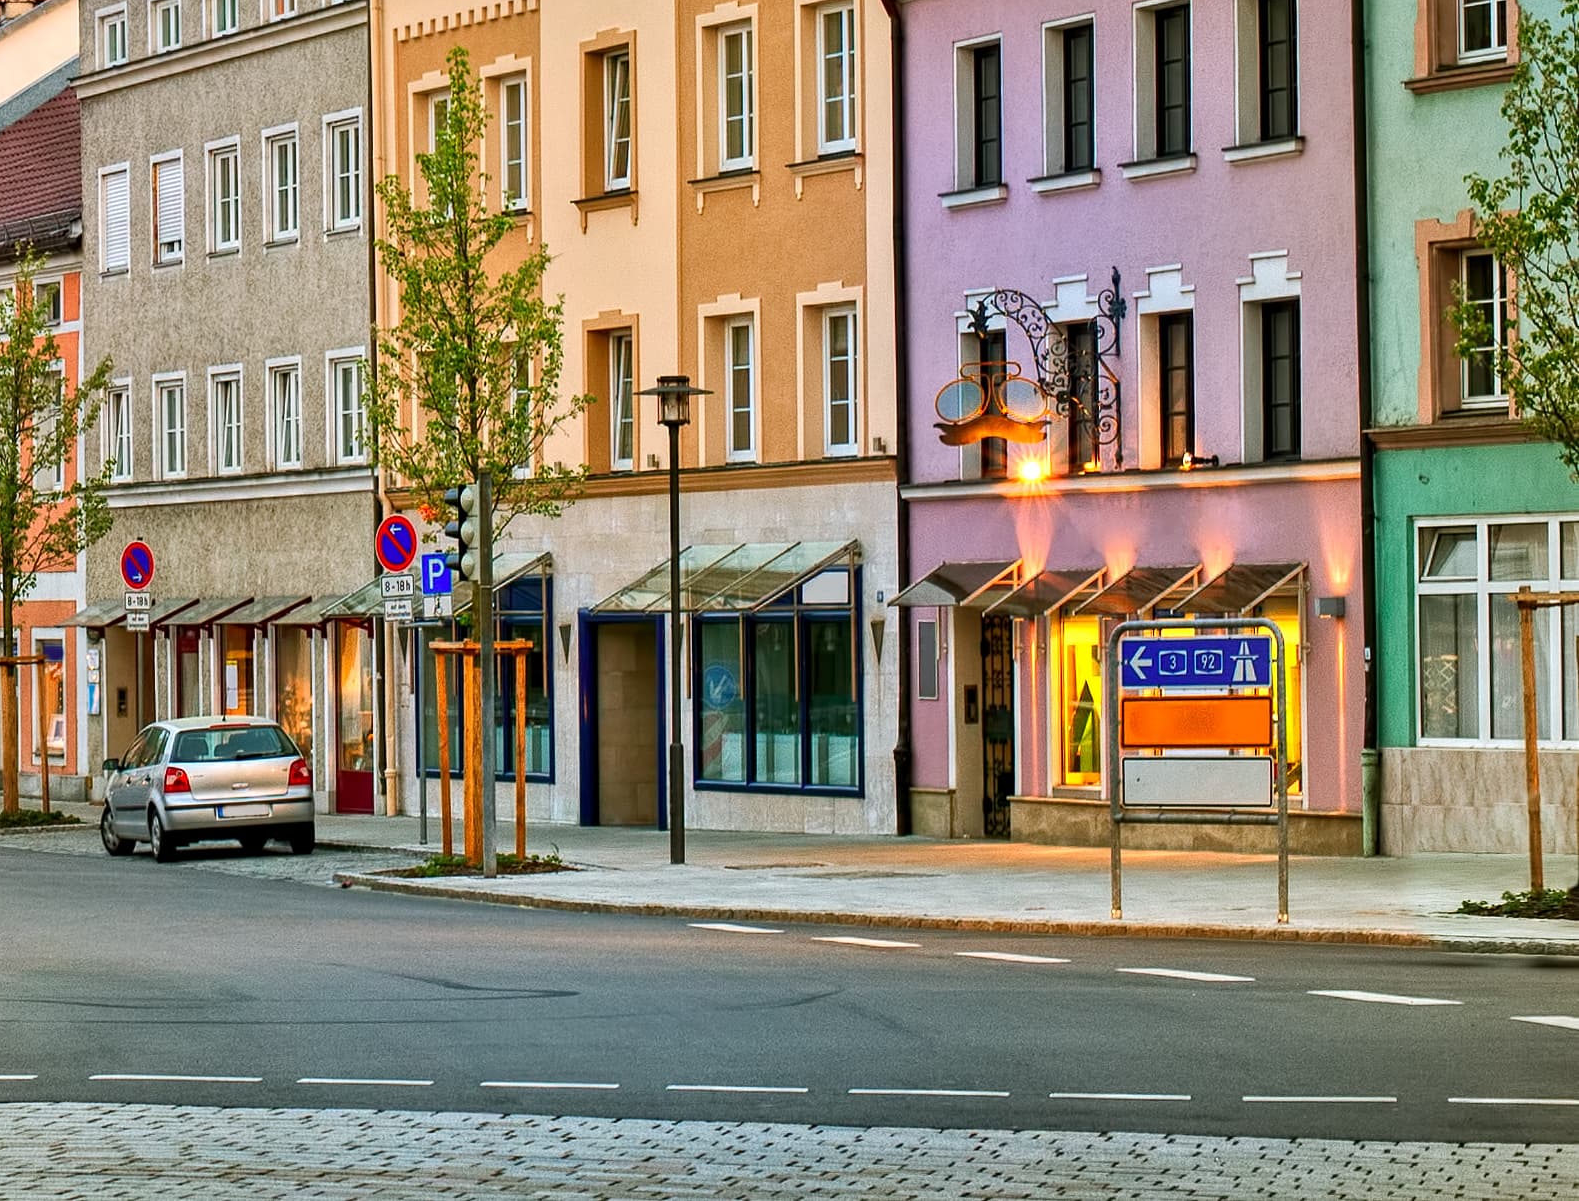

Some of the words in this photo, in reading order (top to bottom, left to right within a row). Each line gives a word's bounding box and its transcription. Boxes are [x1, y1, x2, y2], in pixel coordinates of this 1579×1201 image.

[428, 558, 444, 589] P
[1169, 655, 1177, 670] 3
[1201, 654, 1215, 669] 92
